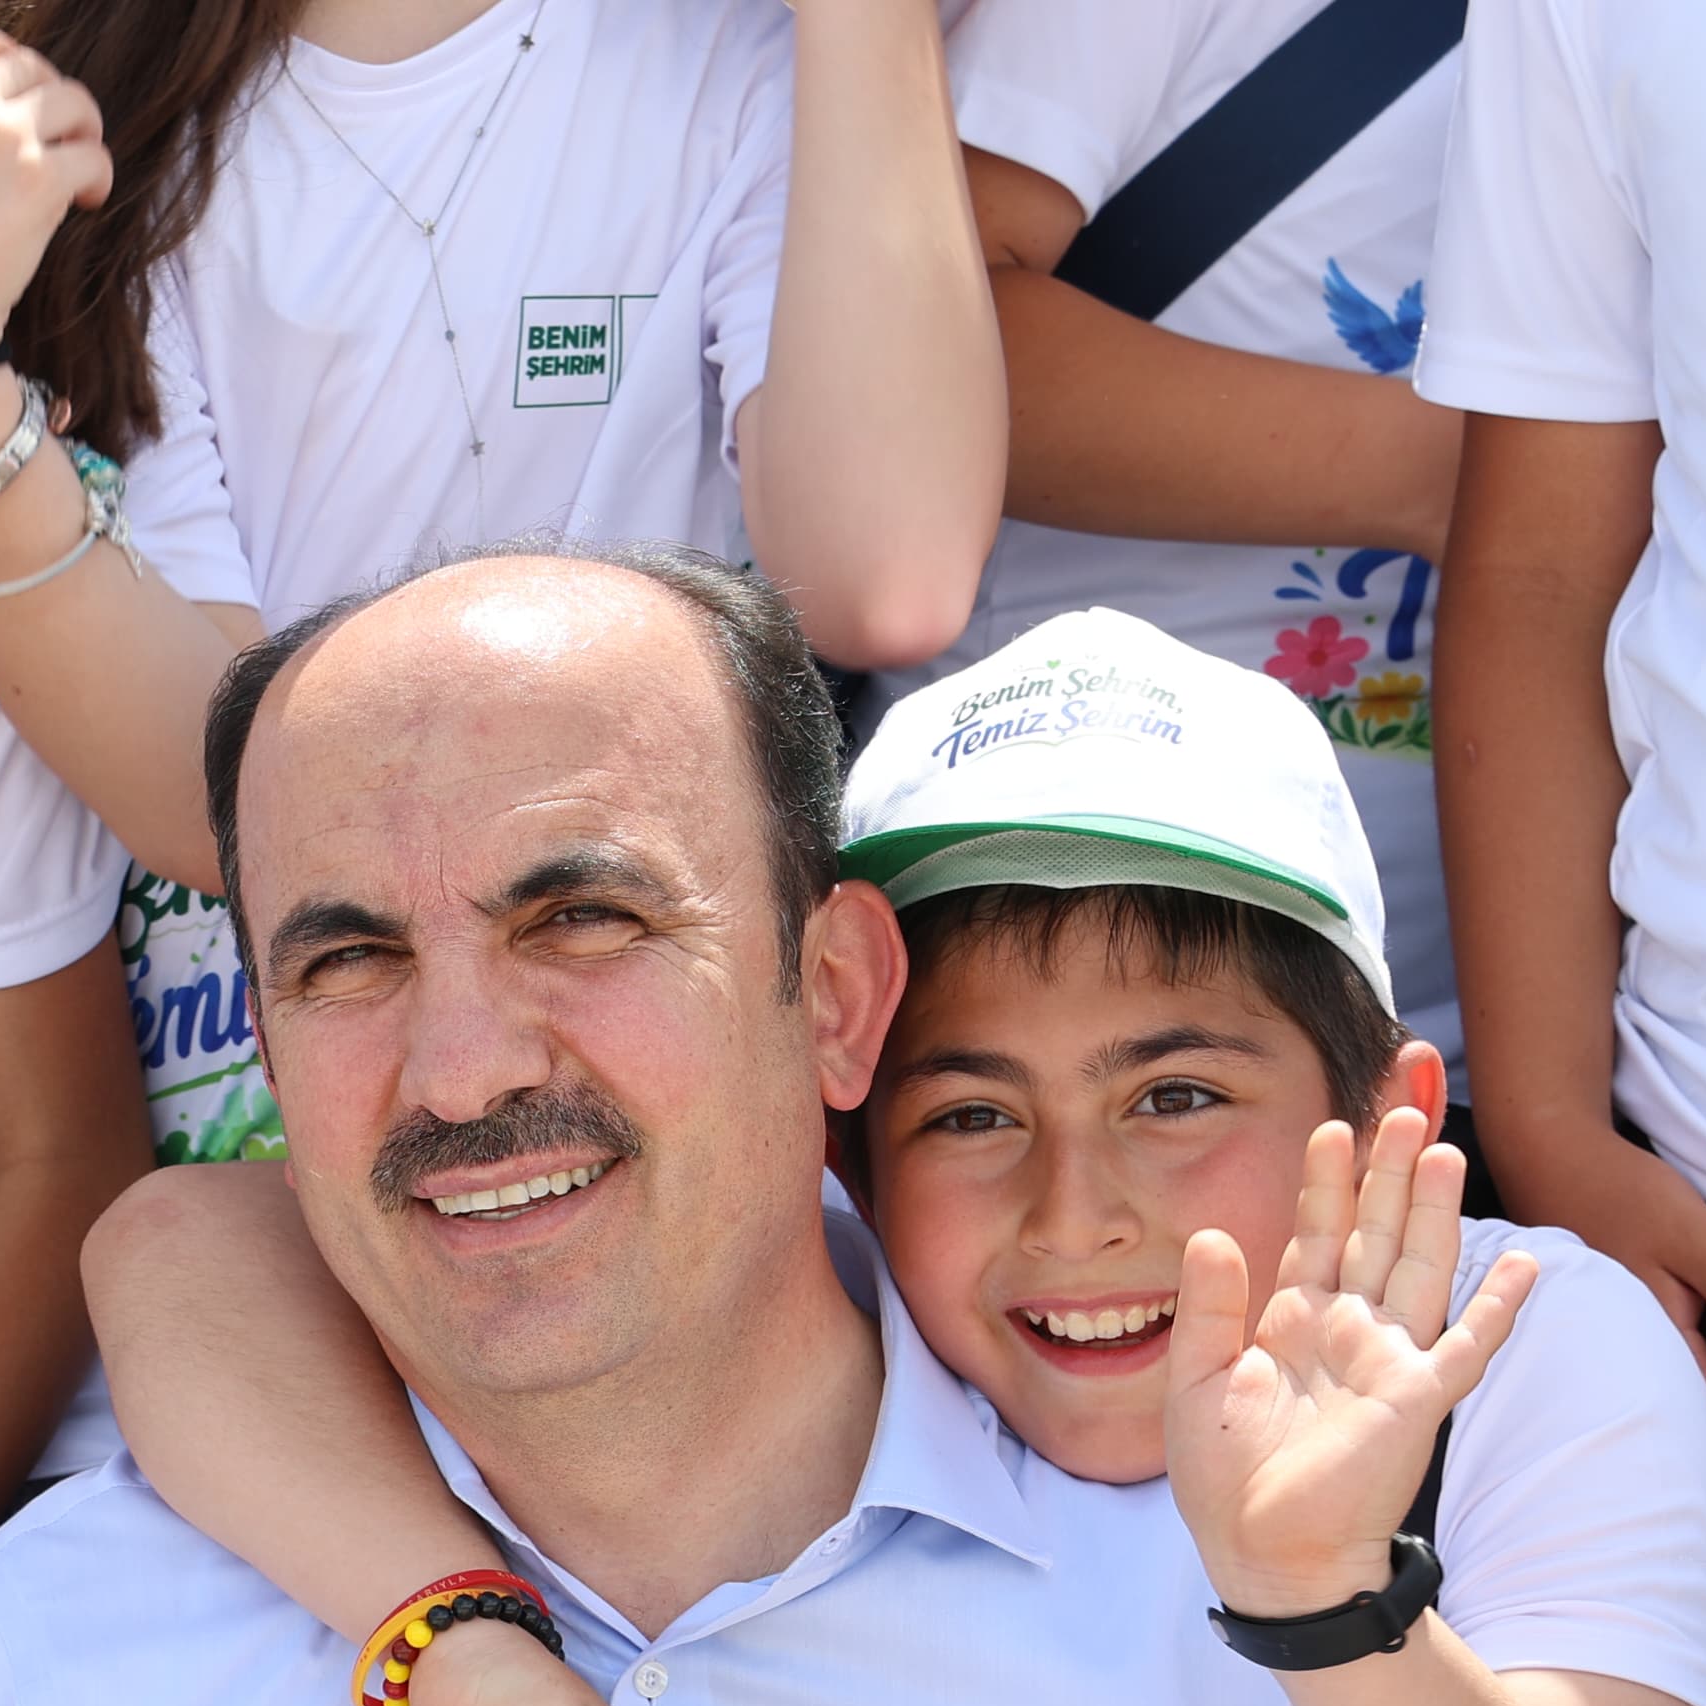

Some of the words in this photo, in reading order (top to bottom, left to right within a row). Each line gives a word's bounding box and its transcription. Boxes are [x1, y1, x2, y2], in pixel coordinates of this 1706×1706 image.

[951, 675, 1054, 727] Benim
[931, 708, 1048, 769] Temiz
[1054, 699, 1182, 745] Şehrim
